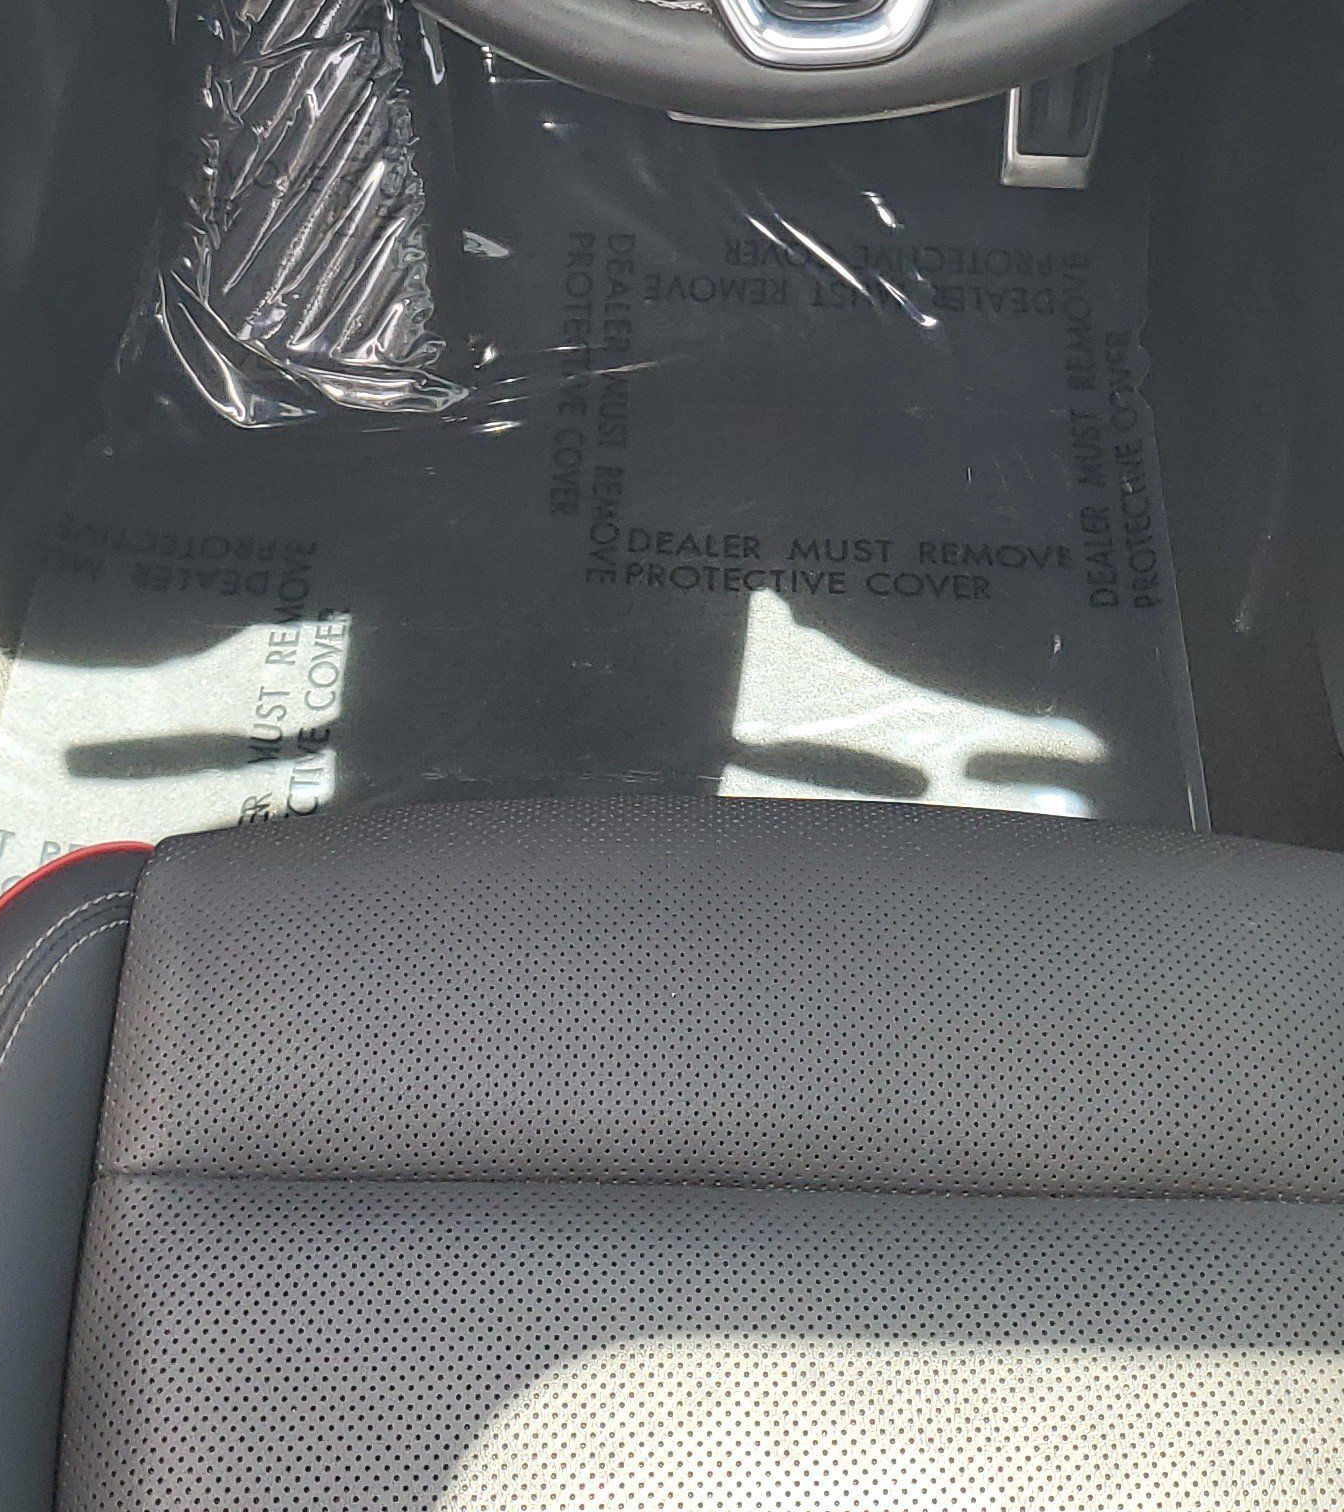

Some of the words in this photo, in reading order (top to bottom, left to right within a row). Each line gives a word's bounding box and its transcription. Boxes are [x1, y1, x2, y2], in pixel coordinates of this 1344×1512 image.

[626, 528, 762, 560] DEALER
[788, 538, 894, 565] MUST
[919, 544, 1073, 571] REMOVE
[625, 563, 847, 595] PROTECTIVE
[865, 571, 993, 601] COVER
[246, 686, 290, 764] MUST
